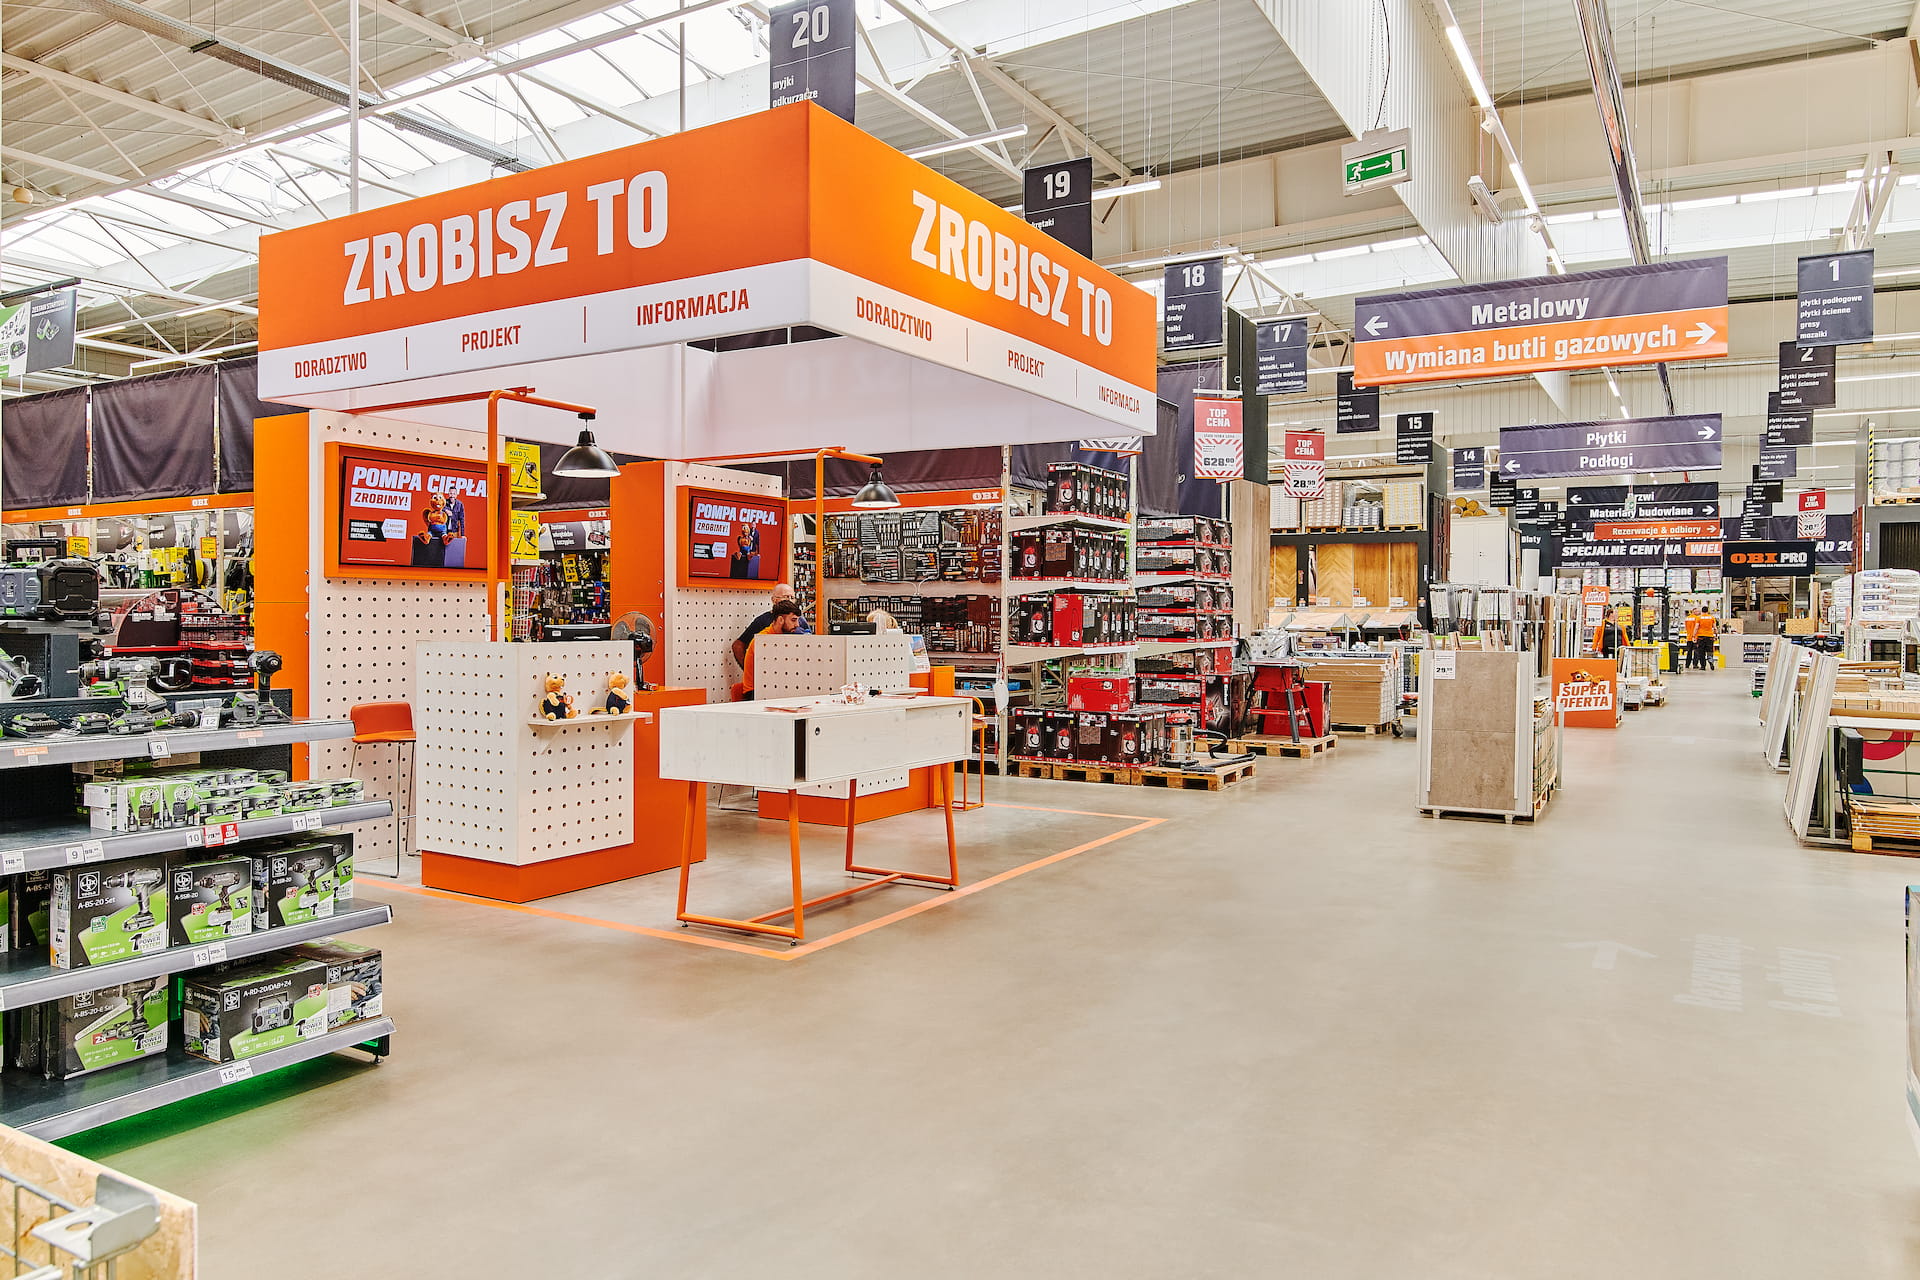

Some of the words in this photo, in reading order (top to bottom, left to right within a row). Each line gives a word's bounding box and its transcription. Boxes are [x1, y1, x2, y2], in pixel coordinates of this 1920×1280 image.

[792, 5, 829, 48] 20
[773, 75, 794, 91] myjki
[1043, 171, 1071, 200] 19
[343, 191, 568, 306] ZROBISZ
[587, 170, 668, 256] TO
[911, 189, 1070, 327] ZROBISZ
[1077, 276, 1112, 346] TO
[1828, 260, 1840, 281] 1
[1182, 265, 1206, 288] 18
[637, 288, 749, 326] INFORMACJA
[1800, 298, 1821, 307] płytki
[1822, 295, 1862, 306] podłogowe
[1471, 297, 1589, 326] Metalowy
[1800, 309, 1821, 319] płytki
[1822, 307, 1851, 316] ścienne
[856, 296, 932, 341] DORADZTWO
[1800, 321, 1820, 330] gresy
[461, 325, 521, 352] PROJEKT
[1272, 324, 1292, 343] 17
[1800, 330, 1828, 339] mozaiki
[1385, 345, 1485, 374] Wymiana
[1493, 337, 1546, 363] butli
[1554, 325, 1676, 362] gazowych
[294, 351, 368, 379] DORADZTWO
[1007, 349, 1045, 378] PROJEKT
[1098, 385, 1140, 414] INFORMACJA
[1209, 409, 1227, 418] TOP
[1206, 418, 1230, 428] CENA
[1407, 416, 1423, 430] 15
[1297, 439, 1313, 448] TOP
[1586, 430, 1627, 446] Płytki
[1294, 447, 1315, 456] CENA
[1463, 450, 1476, 461] 14
[1579, 453, 1633, 470] Podłogi
[352, 466, 422, 491] POMPA
[354, 492, 408, 506] ZROBIMY!
[972, 491, 999, 501] OBI
[1522, 490, 1533, 499] 12
[695, 503, 737, 521] POMPA
[1543, 503, 1552, 511] 11
[1639, 506, 1693, 517] budowlane
[697, 522, 728, 533] ZROBIMY!
[1612, 527, 1658, 536] Rezerwacje
[1661, 526, 1668, 534] &
[1670, 525, 1701, 535] odbiory
[1521, 536, 1541, 545] Blaty
[1561, 545, 1627, 557] SPECJALNE
[1629, 544, 1662, 555] CENY
[1663, 543, 1682, 554] NA
[1730, 552, 1778, 564] OBI
[1780, 552, 1808, 564] PRO
[131, 690, 144, 699] 14
[1562, 684, 1606, 697] SUPER
[204, 718, 216, 726] 12
[156, 744, 163, 752] 9
[295, 819, 304, 828] 11
[188, 833, 199, 843] 10
[71, 851, 78, 860] 9
[78, 900, 104, 910] A-BS-20
[105, 897, 116, 905] Set
[196, 952, 208, 962] 13
[303, 1021, 323, 1031] POWER
[141, 1035, 162, 1043] POWER
[223, 1070, 235, 1080] 15
